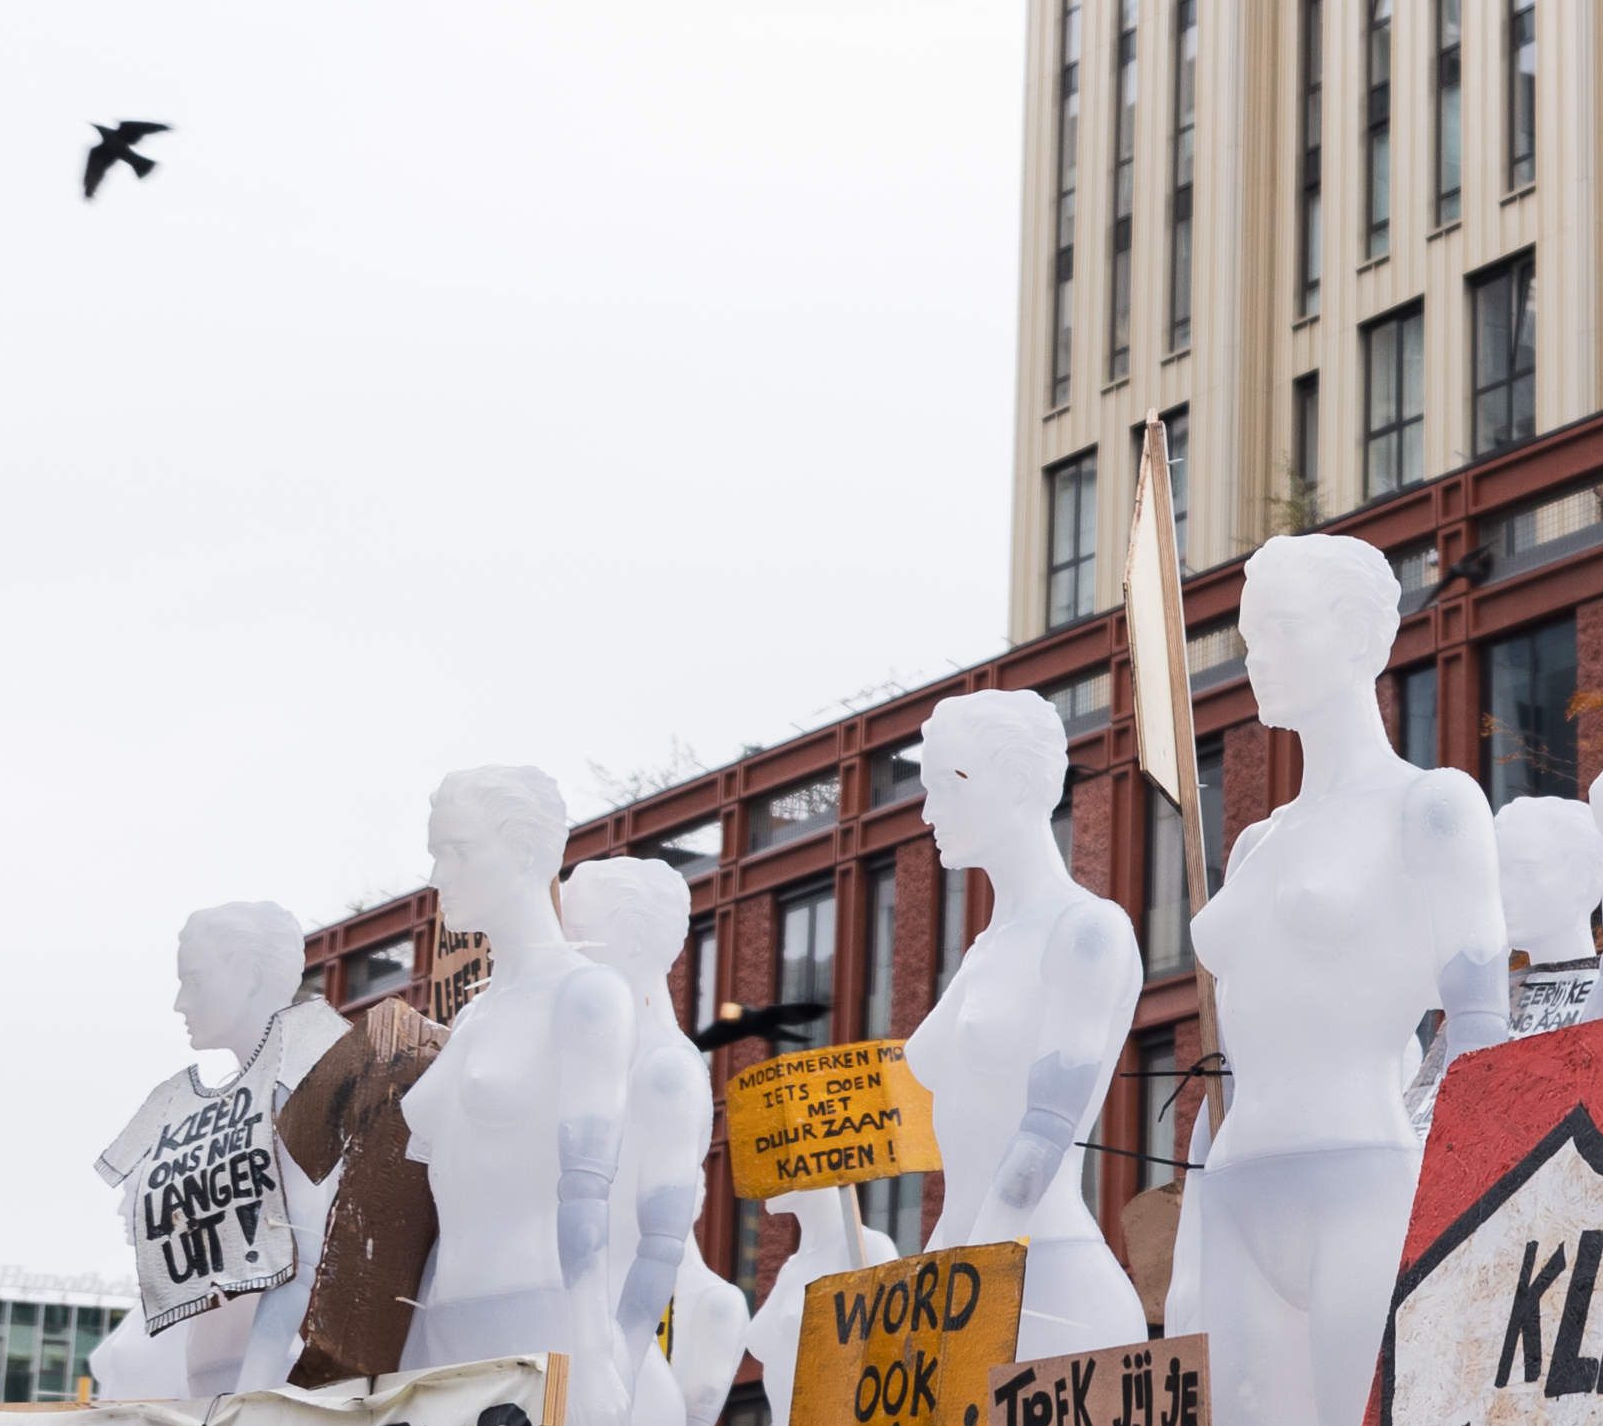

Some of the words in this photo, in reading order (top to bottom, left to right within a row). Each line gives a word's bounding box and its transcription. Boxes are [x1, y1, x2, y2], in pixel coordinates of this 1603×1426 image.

[739, 1050, 869, 1091] MODEMERKEN
[877, 1047, 905, 1063] MO
[763, 1083, 810, 1109] IETS
[826, 1072, 881, 1095] DOEN
[152, 1087, 252, 1161] KLEED
[807, 1096, 852, 1118] MET
[148, 1147, 205, 1190] ONS
[207, 1112, 263, 1171] NIET
[144, 1148, 276, 1241] LANGER
[834, 1261, 980, 1346] WORD
[854, 1350, 938, 1422] OOK
